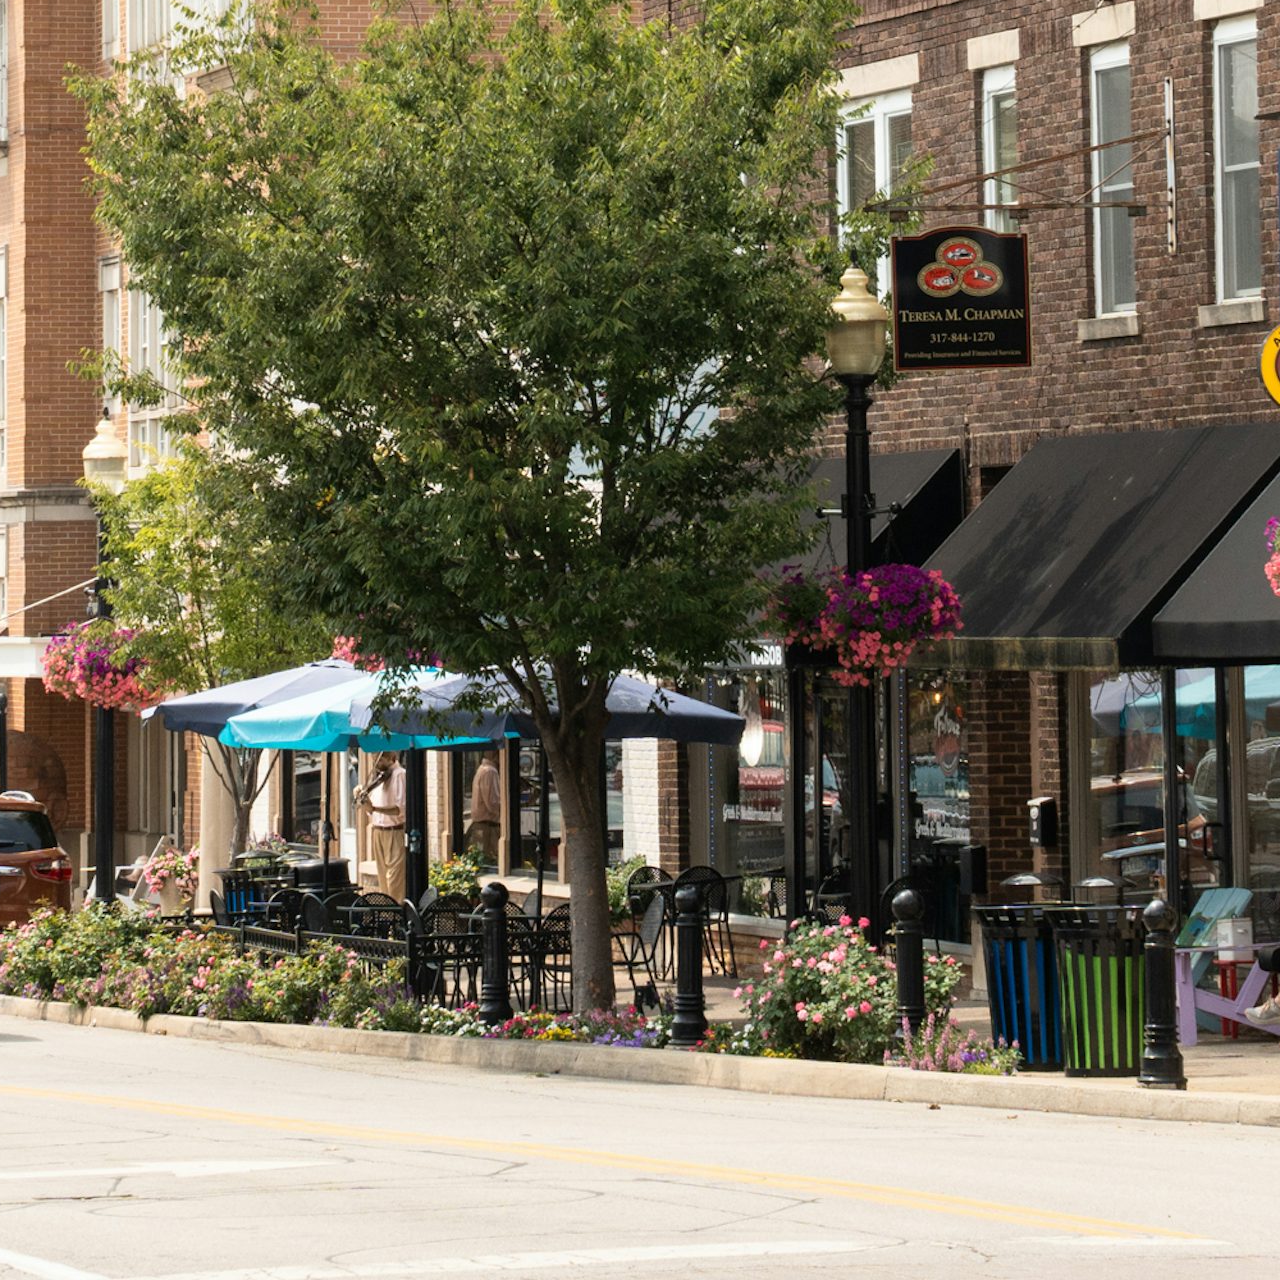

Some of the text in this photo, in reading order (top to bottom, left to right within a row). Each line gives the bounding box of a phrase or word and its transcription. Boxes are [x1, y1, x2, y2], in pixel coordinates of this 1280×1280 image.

[900, 307, 1024, 323] TERESA M. CHAPMAN
[929, 331, 995, 343] 317-844-1270
